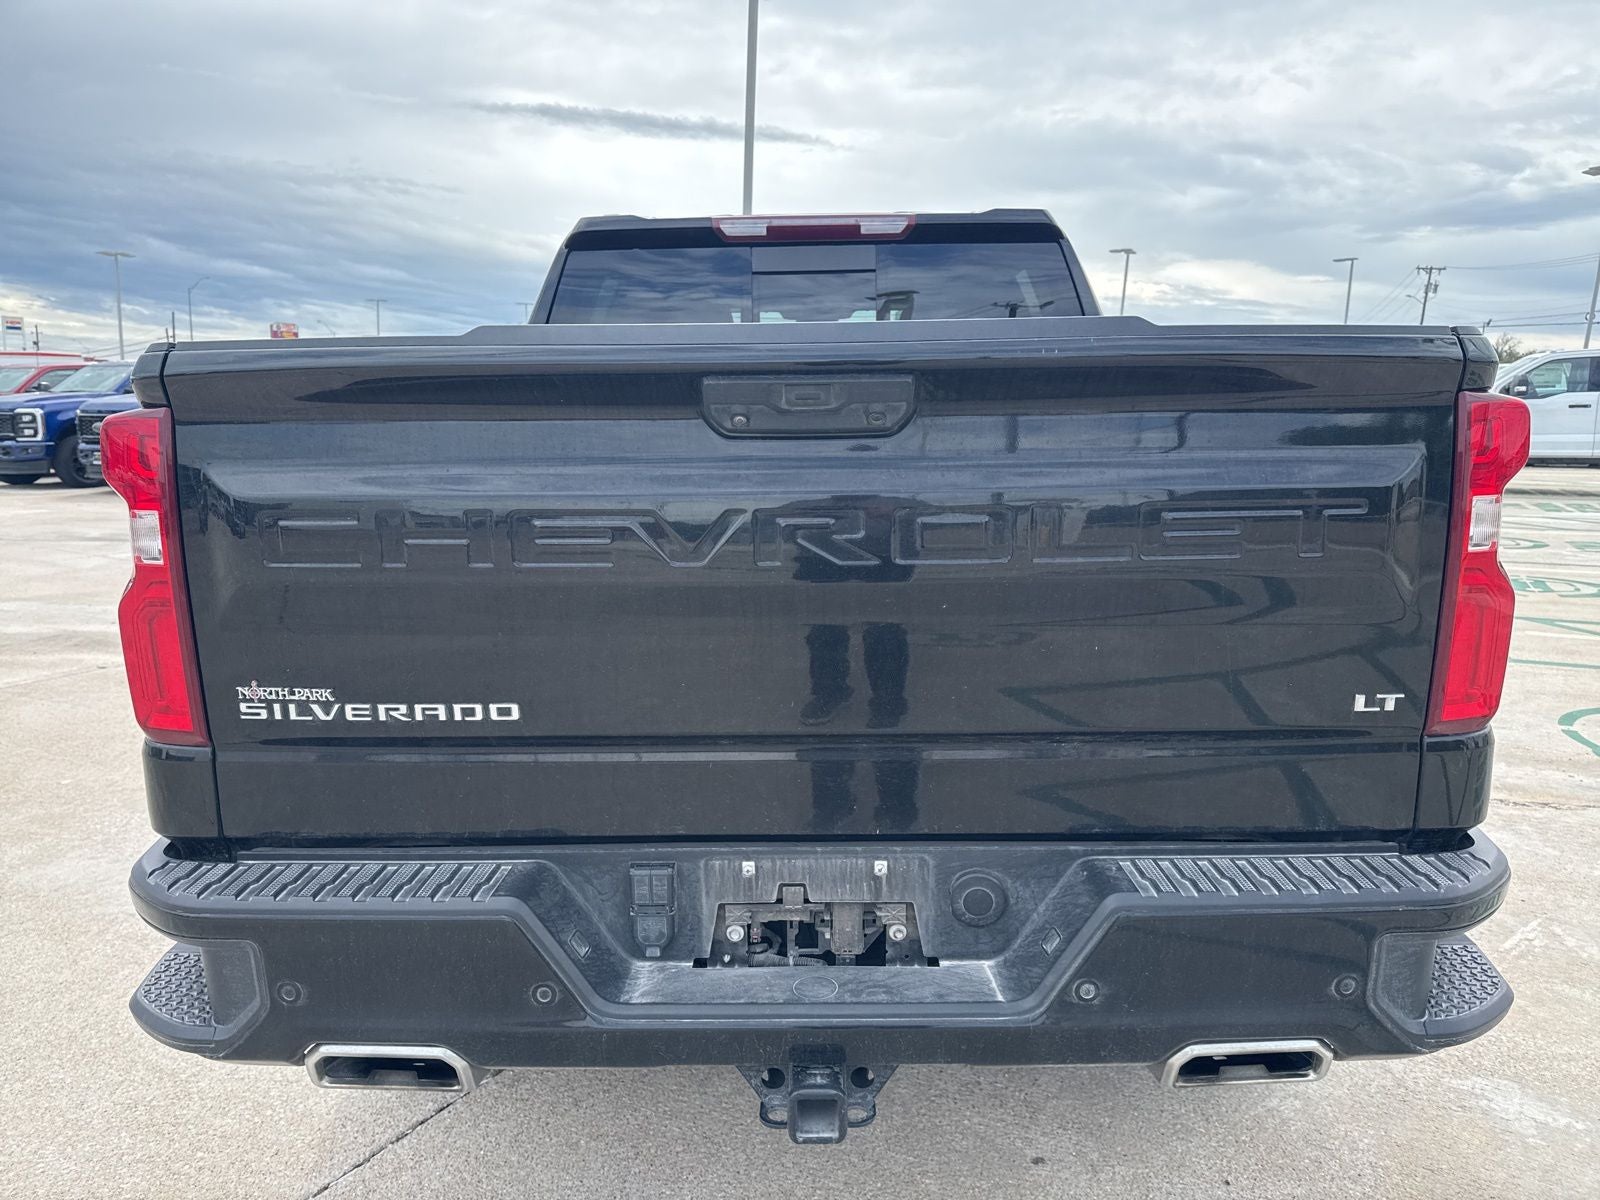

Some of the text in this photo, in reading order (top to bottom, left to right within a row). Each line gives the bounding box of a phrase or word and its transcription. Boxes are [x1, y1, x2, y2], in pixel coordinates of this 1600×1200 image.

[257, 498, 1369, 568] CHEVROLET
[235, 684, 335, 701] NORTH PARK
[239, 702, 521, 721] SILVERADO
[1353, 693, 1405, 712] LT
